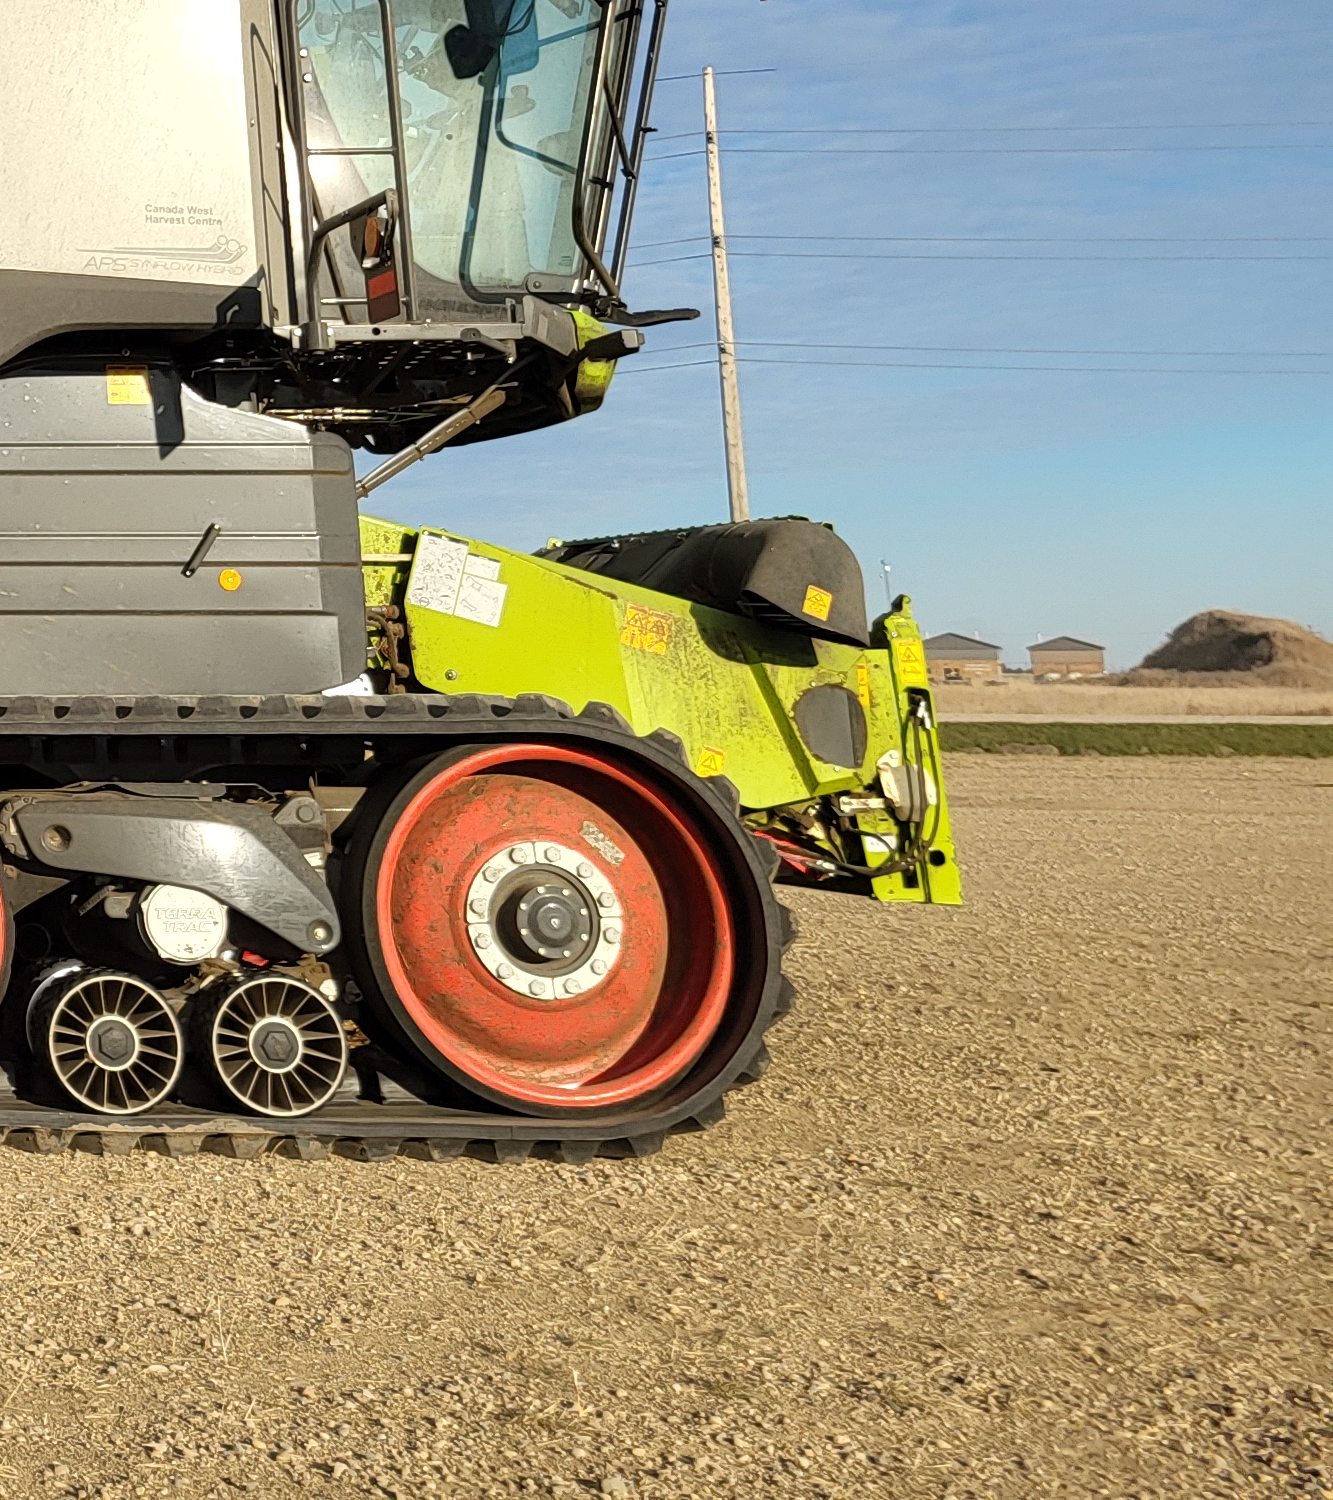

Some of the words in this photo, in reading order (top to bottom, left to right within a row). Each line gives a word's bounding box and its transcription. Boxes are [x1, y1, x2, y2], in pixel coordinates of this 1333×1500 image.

[144, 204, 184, 215] Canada
[186, 205, 214, 216] West
[144, 214, 186, 226] Harvest
[82, 256, 129, 272] APS
[128, 258, 195, 273] SYNFLOW
[196, 263, 245, 276] HYBRID
[154, 907, 217, 920] TERRA
[162, 920, 212, 933] TRAC
